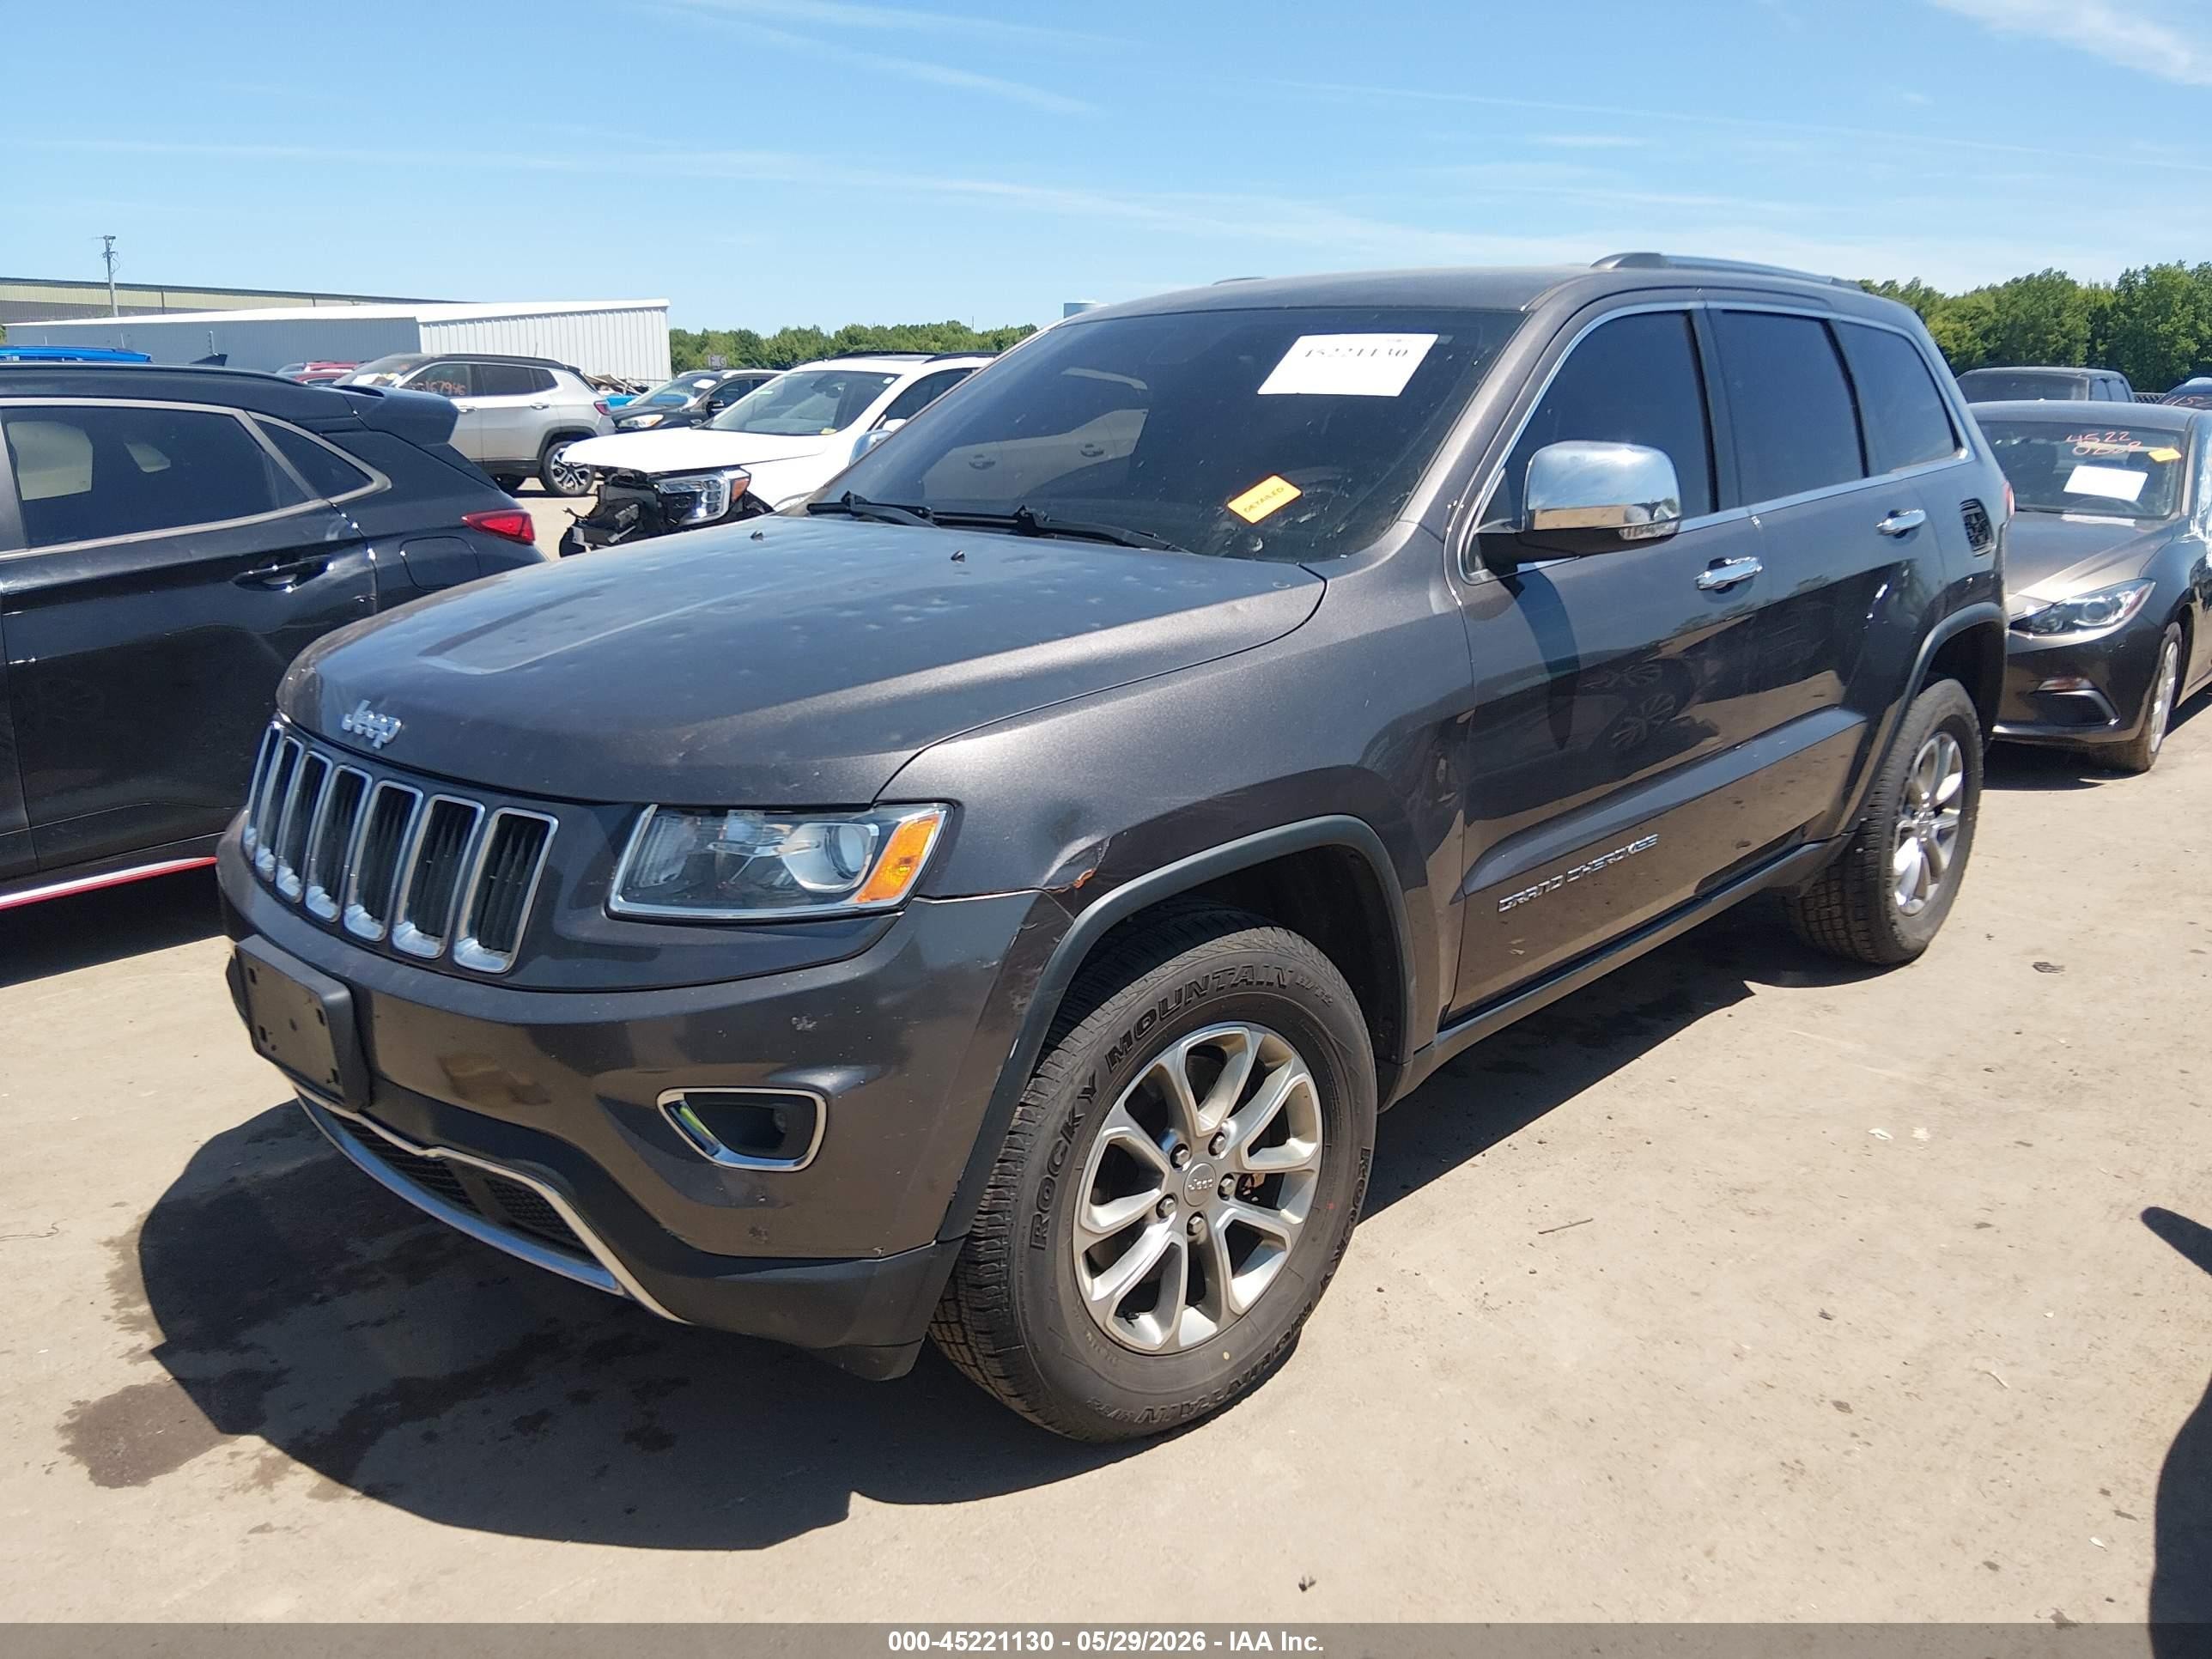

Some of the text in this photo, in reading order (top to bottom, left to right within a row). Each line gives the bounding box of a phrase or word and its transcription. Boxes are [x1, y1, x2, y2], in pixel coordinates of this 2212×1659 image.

[2065, 431, 2130, 444] 4522
[342, 699, 402, 750] Jeep
[1030, 1070, 1097, 1251] ROCKY
[1105, 964, 1293, 1071] MOUNTAIN
